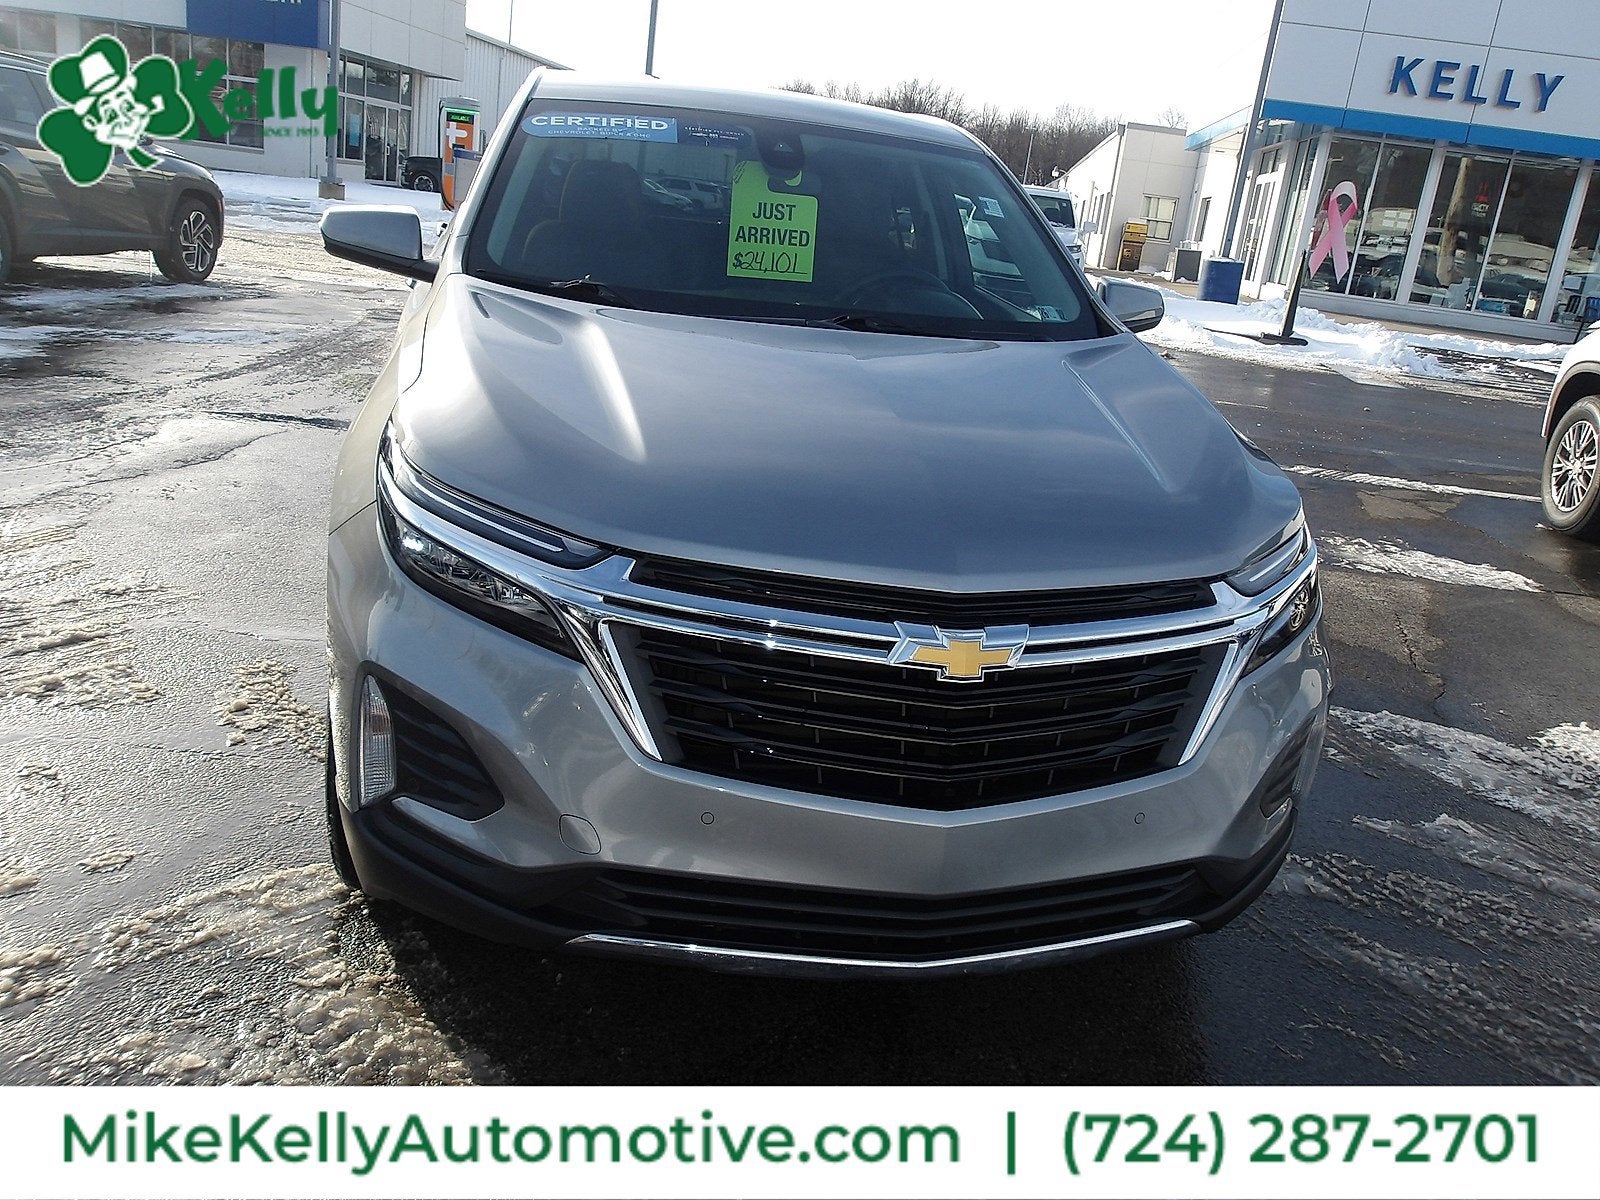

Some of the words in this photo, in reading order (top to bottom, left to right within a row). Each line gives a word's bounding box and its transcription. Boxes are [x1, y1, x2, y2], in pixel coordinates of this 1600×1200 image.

[1388, 55, 1565, 112] KELLY
[531, 116, 668, 130] CERTIFIED
[752, 202, 797, 221] JUST
[735, 225, 810, 248] ARRIVED
[732, 251, 799, 274] $24,101
